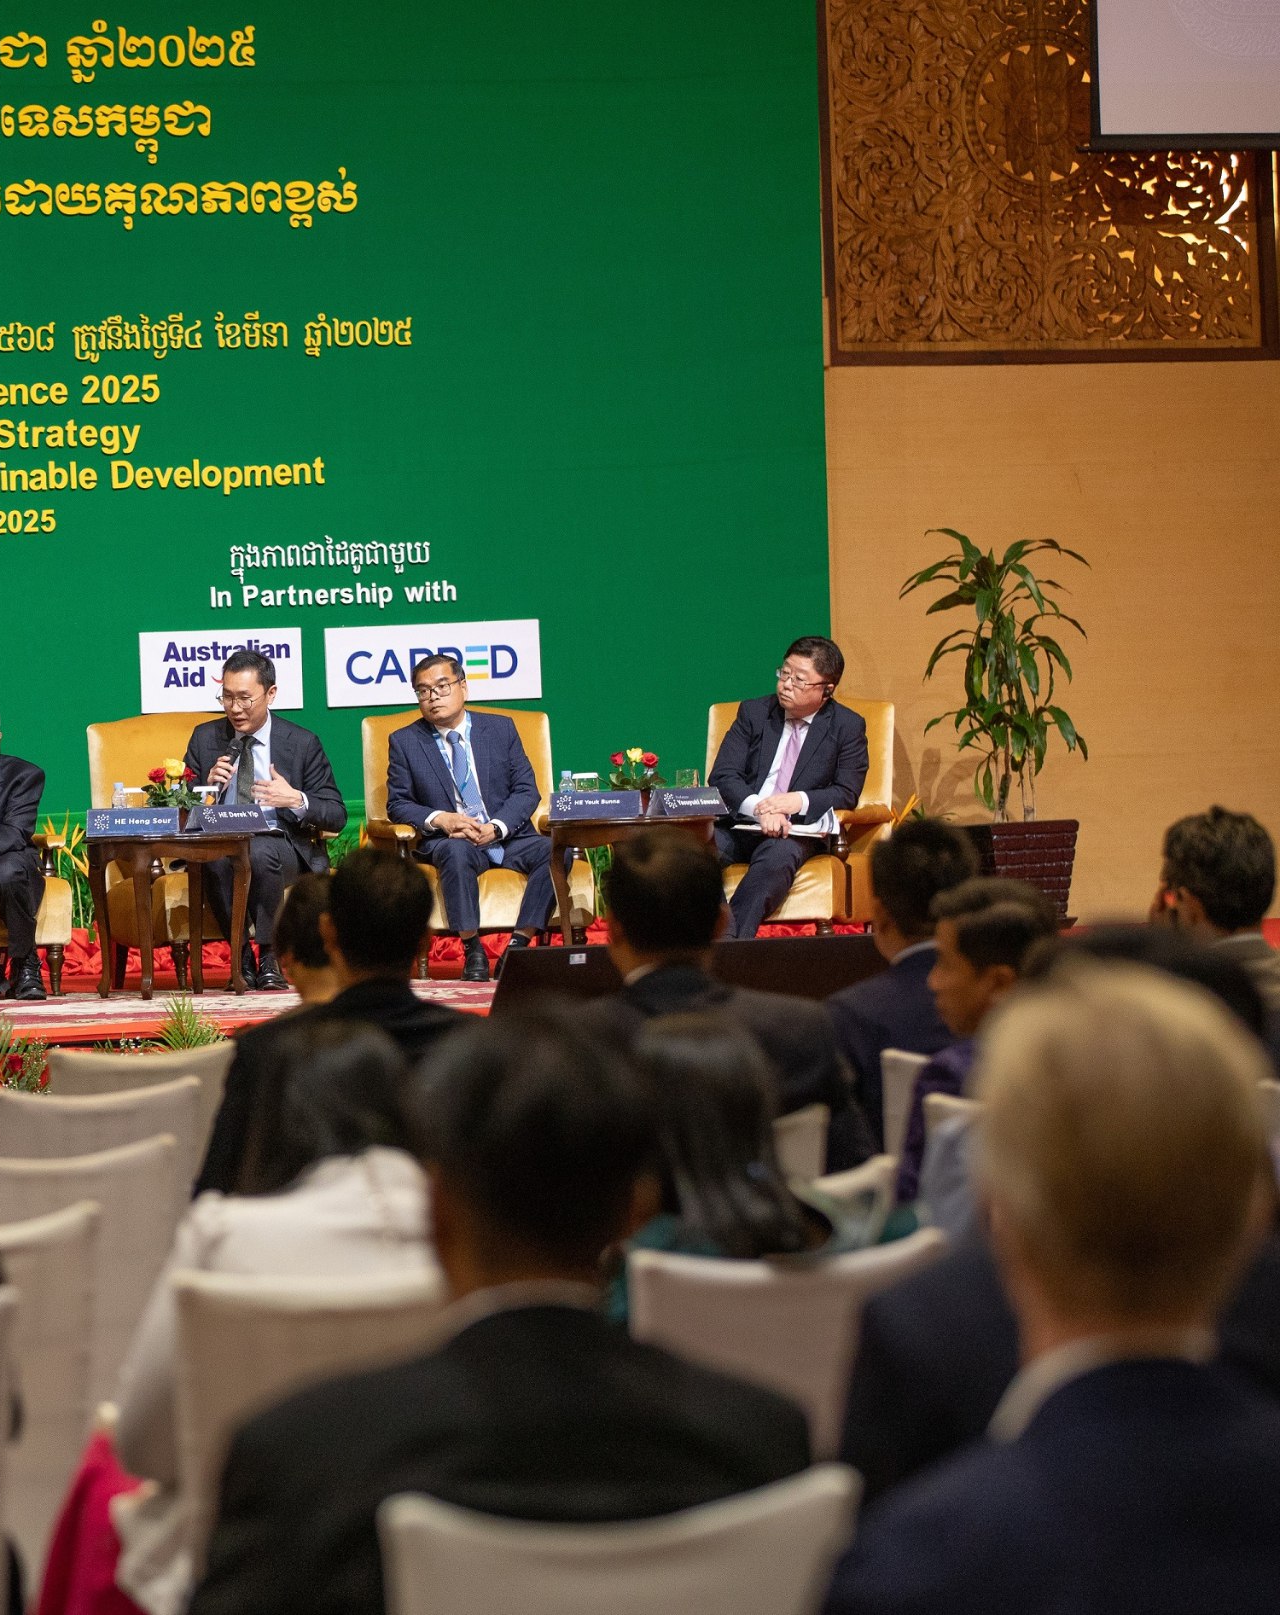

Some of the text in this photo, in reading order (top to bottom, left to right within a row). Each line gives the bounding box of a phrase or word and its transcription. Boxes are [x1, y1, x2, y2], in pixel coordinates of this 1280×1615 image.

[66, 19, 257, 83] ឆ្នាំ២០២៥
[214, 310, 288, 348] ខែមីនា
[304, 312, 412, 357] ឆ្នាំ២០២៥
[81, 373, 160, 404] 2025
[110, 456, 326, 495] Development
[229, 534, 431, 585] ក្នុងភាពជាដៃគូជាមួយ
[210, 579, 457, 609] In Partnership with
[164, 667, 205, 688] Aid
[247, 810, 259, 818] Yip
